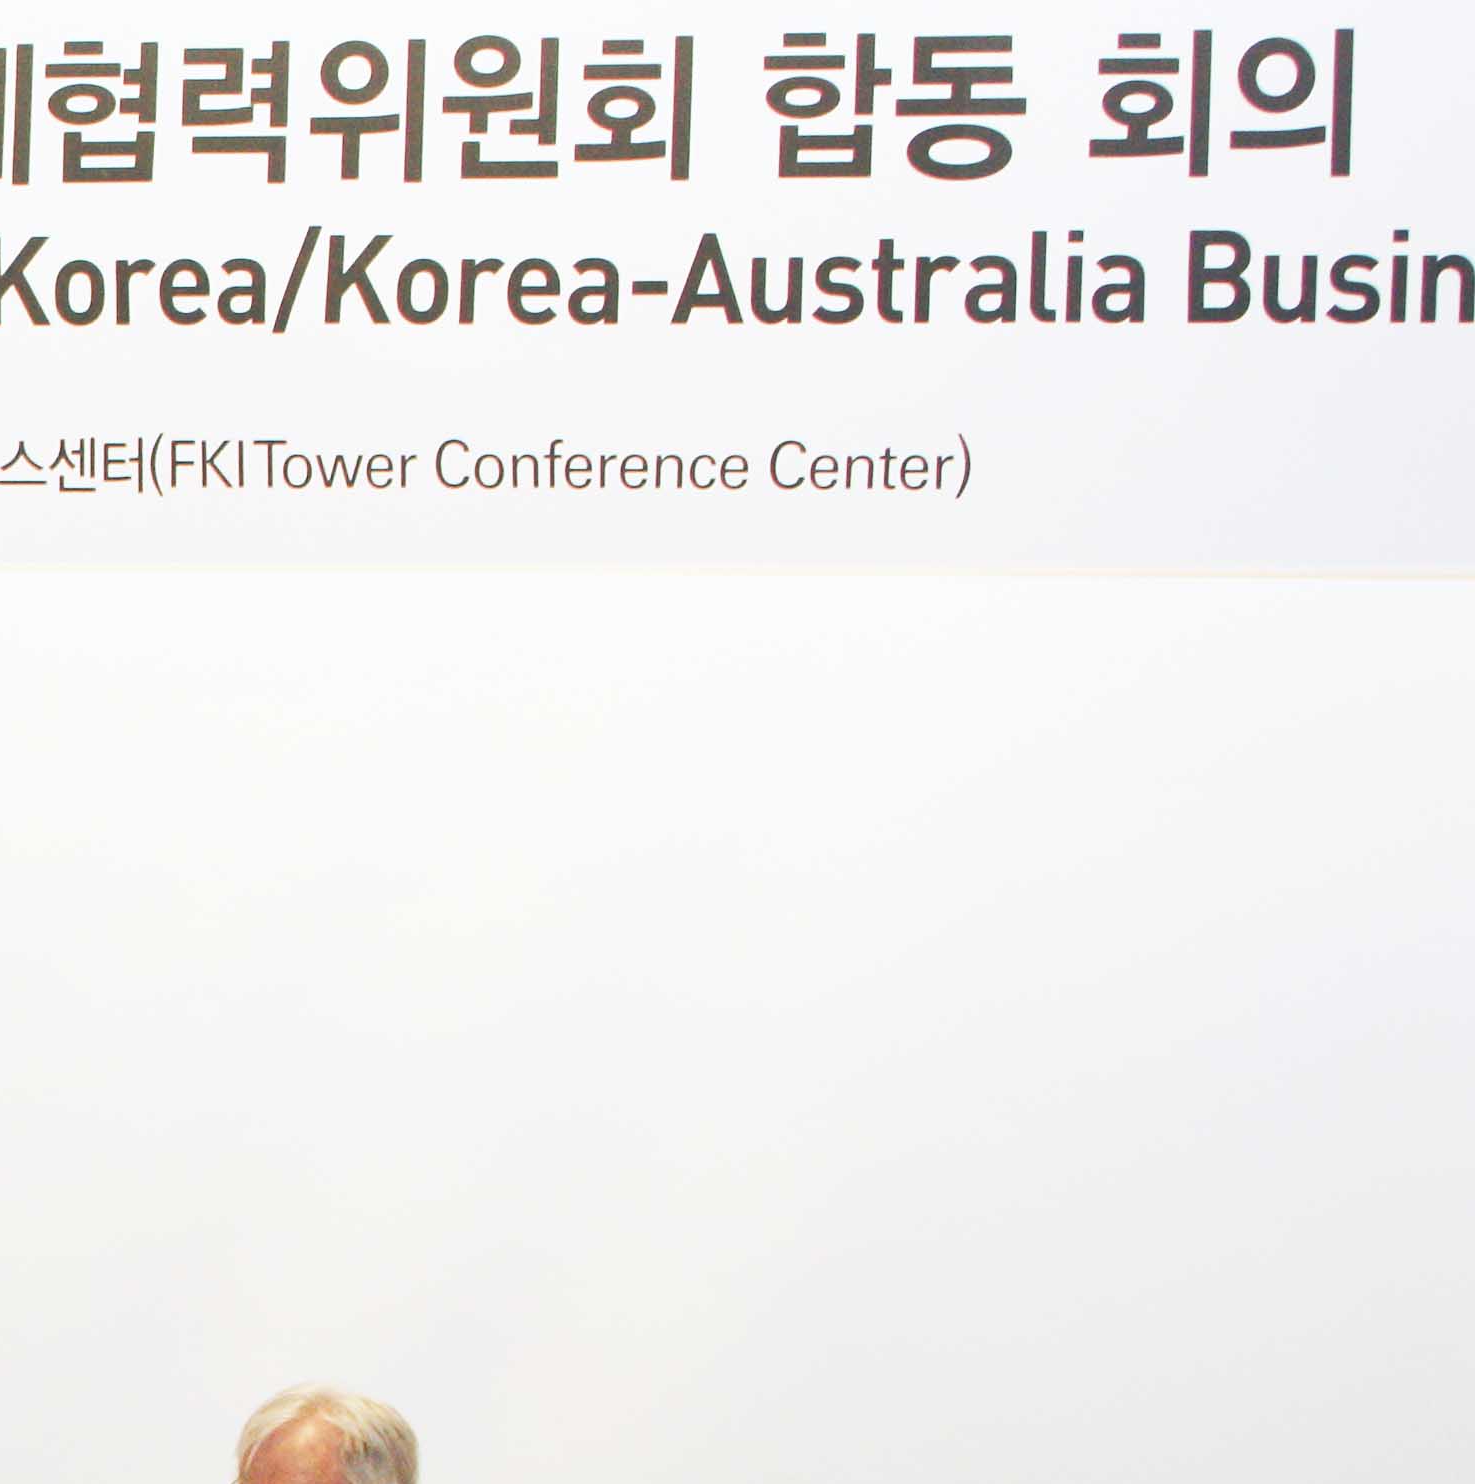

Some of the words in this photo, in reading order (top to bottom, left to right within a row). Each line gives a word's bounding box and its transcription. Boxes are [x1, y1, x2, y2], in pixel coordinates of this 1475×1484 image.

[763, 32, 1027, 181] 합동
[1089, 28, 1354, 177] 회의
[1187, 229, 1475, 324] Busin
[435, 439, 749, 490] Conference
[769, 433, 971, 499] Center)
